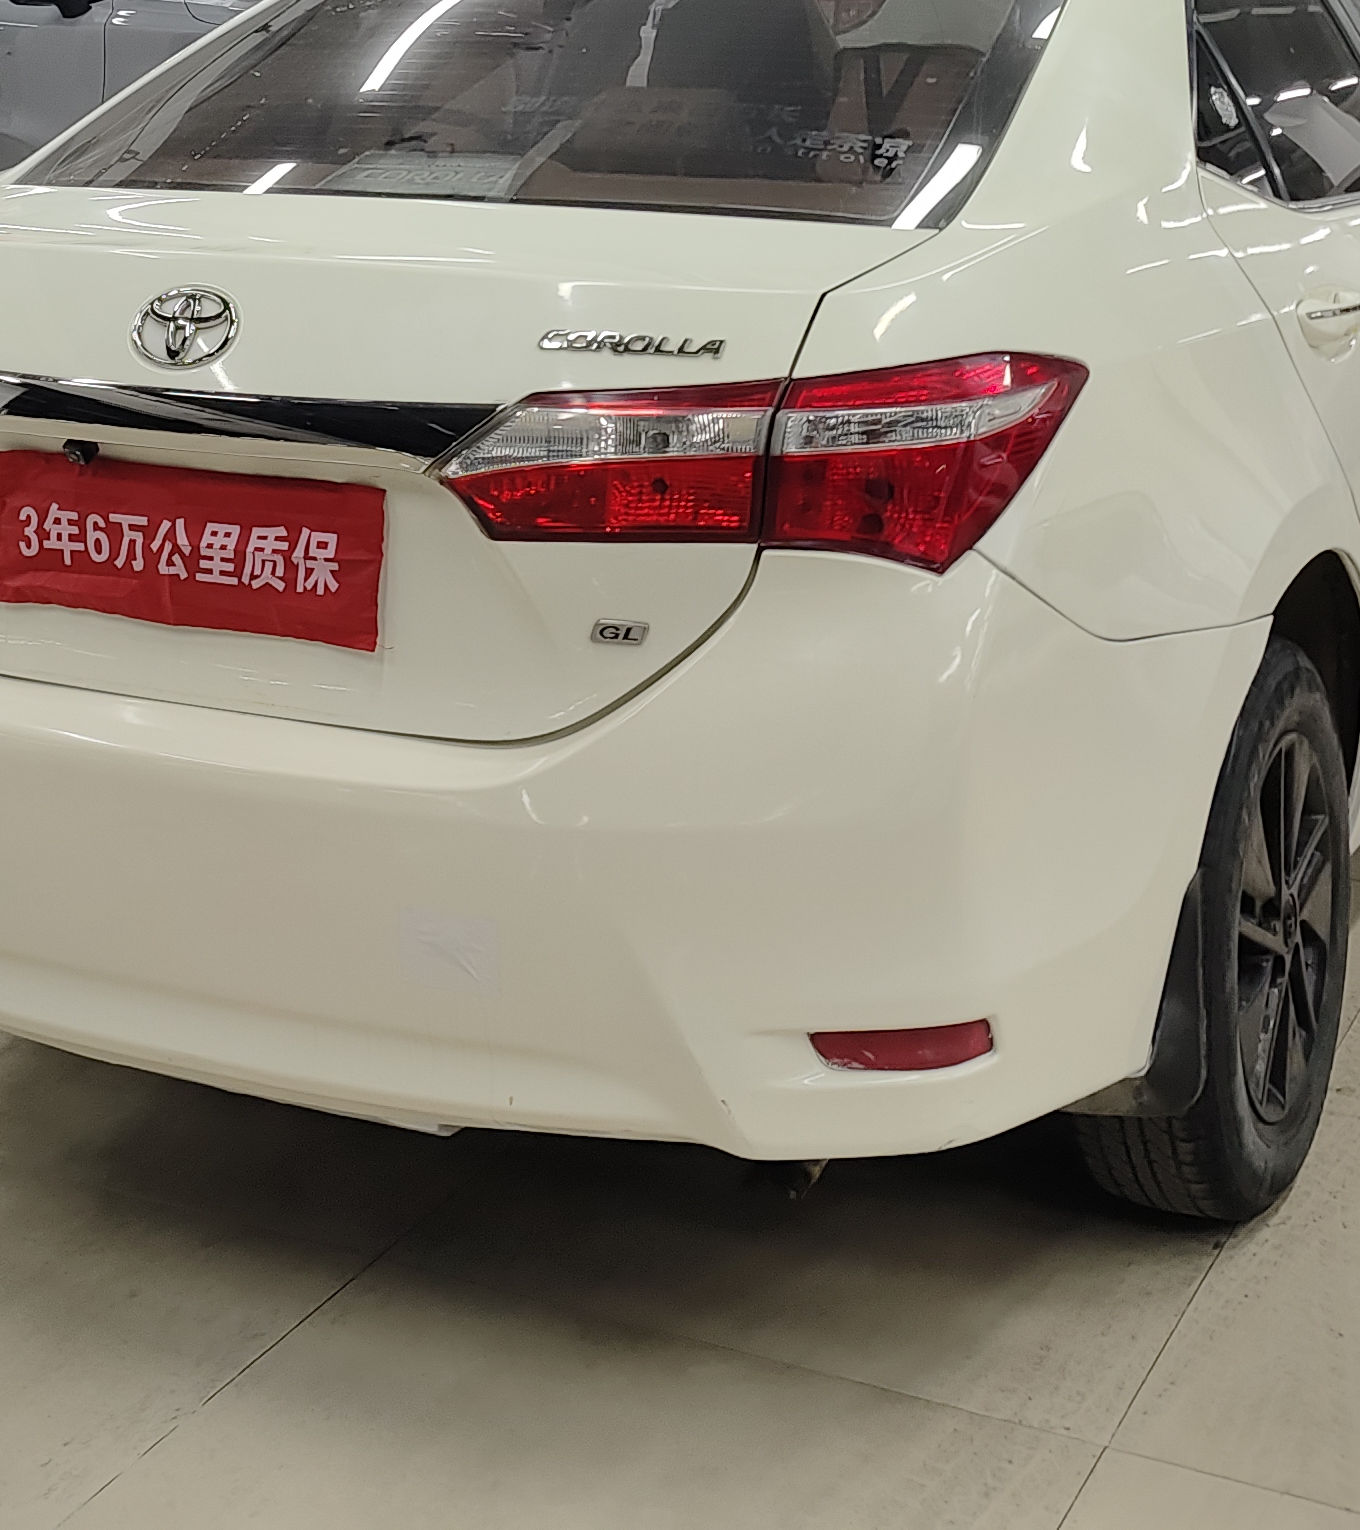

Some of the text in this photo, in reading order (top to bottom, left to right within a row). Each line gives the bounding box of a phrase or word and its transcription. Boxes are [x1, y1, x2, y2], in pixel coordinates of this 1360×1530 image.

[538, 329, 727, 359] COROLLA
[18, 502, 340, 596] 3年6万公里质保
[599, 625, 639, 642] GL
